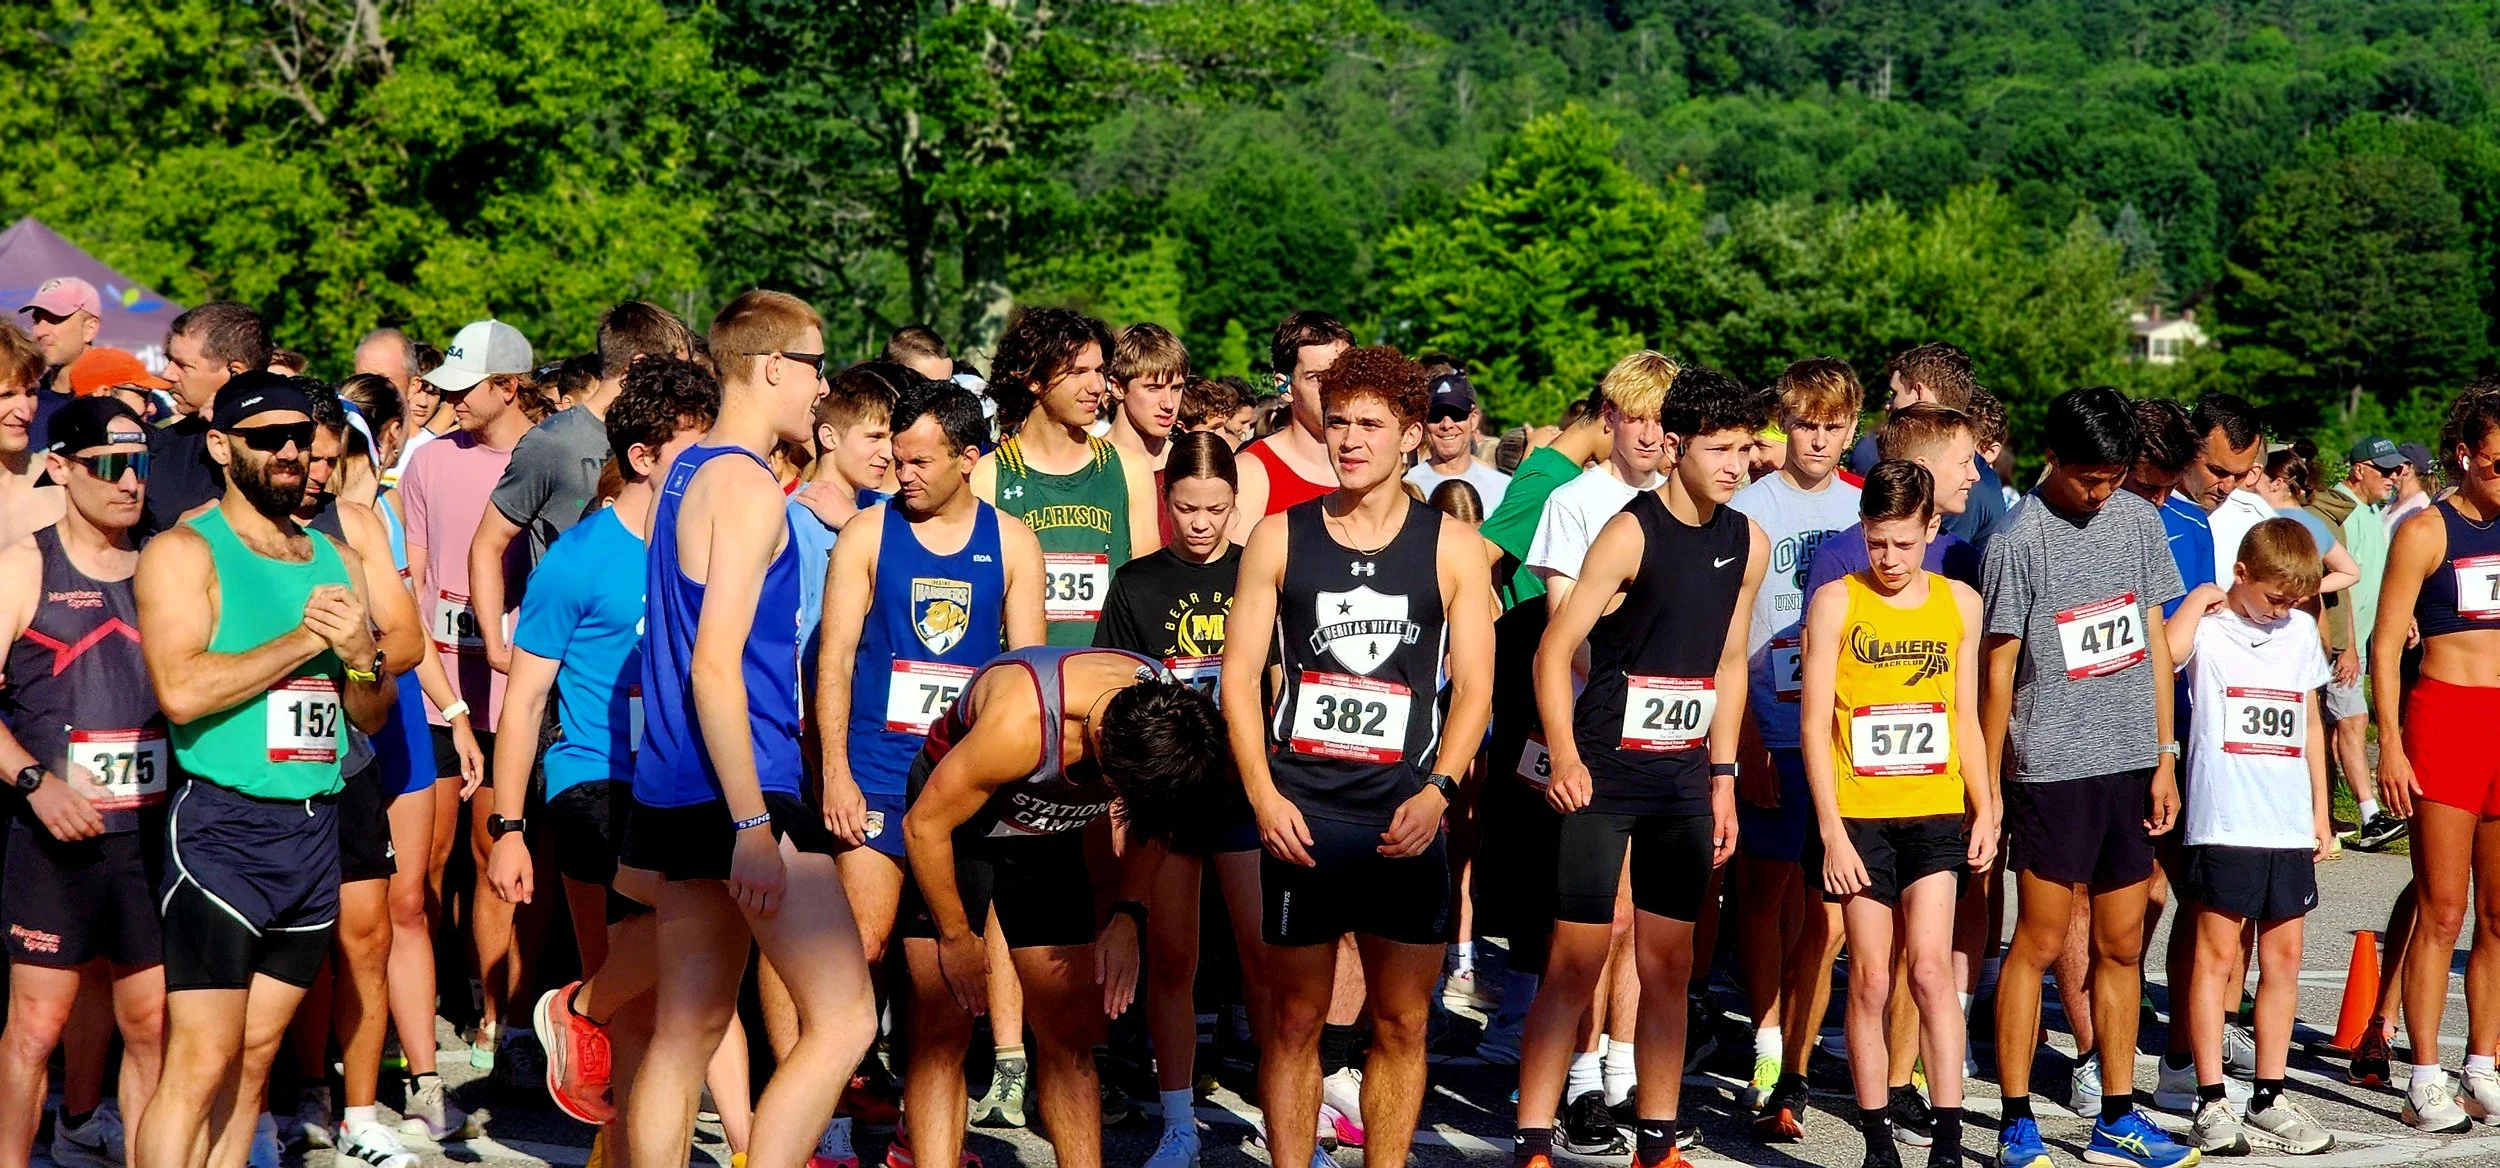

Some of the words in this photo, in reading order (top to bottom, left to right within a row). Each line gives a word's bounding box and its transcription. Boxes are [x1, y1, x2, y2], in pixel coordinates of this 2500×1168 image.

[1022, 505, 1112, 534] CLARKSON
[1323, 621, 1367, 640] VERITAS
[1371, 620, 1403, 633] VITAE
[2081, 615, 2134, 655] 472
[1869, 640, 1948, 661] LAKERS
[1873, 661, 1901, 669] TRACK
[288, 700, 337, 738] 152
[1313, 694, 1388, 738] 382
[1642, 698, 1702, 731] 240
[2242, 705, 2296, 738] 399
[1871, 723, 1935, 756] 572
[90, 750, 155, 787] 375
[1012, 793, 1113, 818] STATION
[1280, 890, 1291, 936] SALOMON
